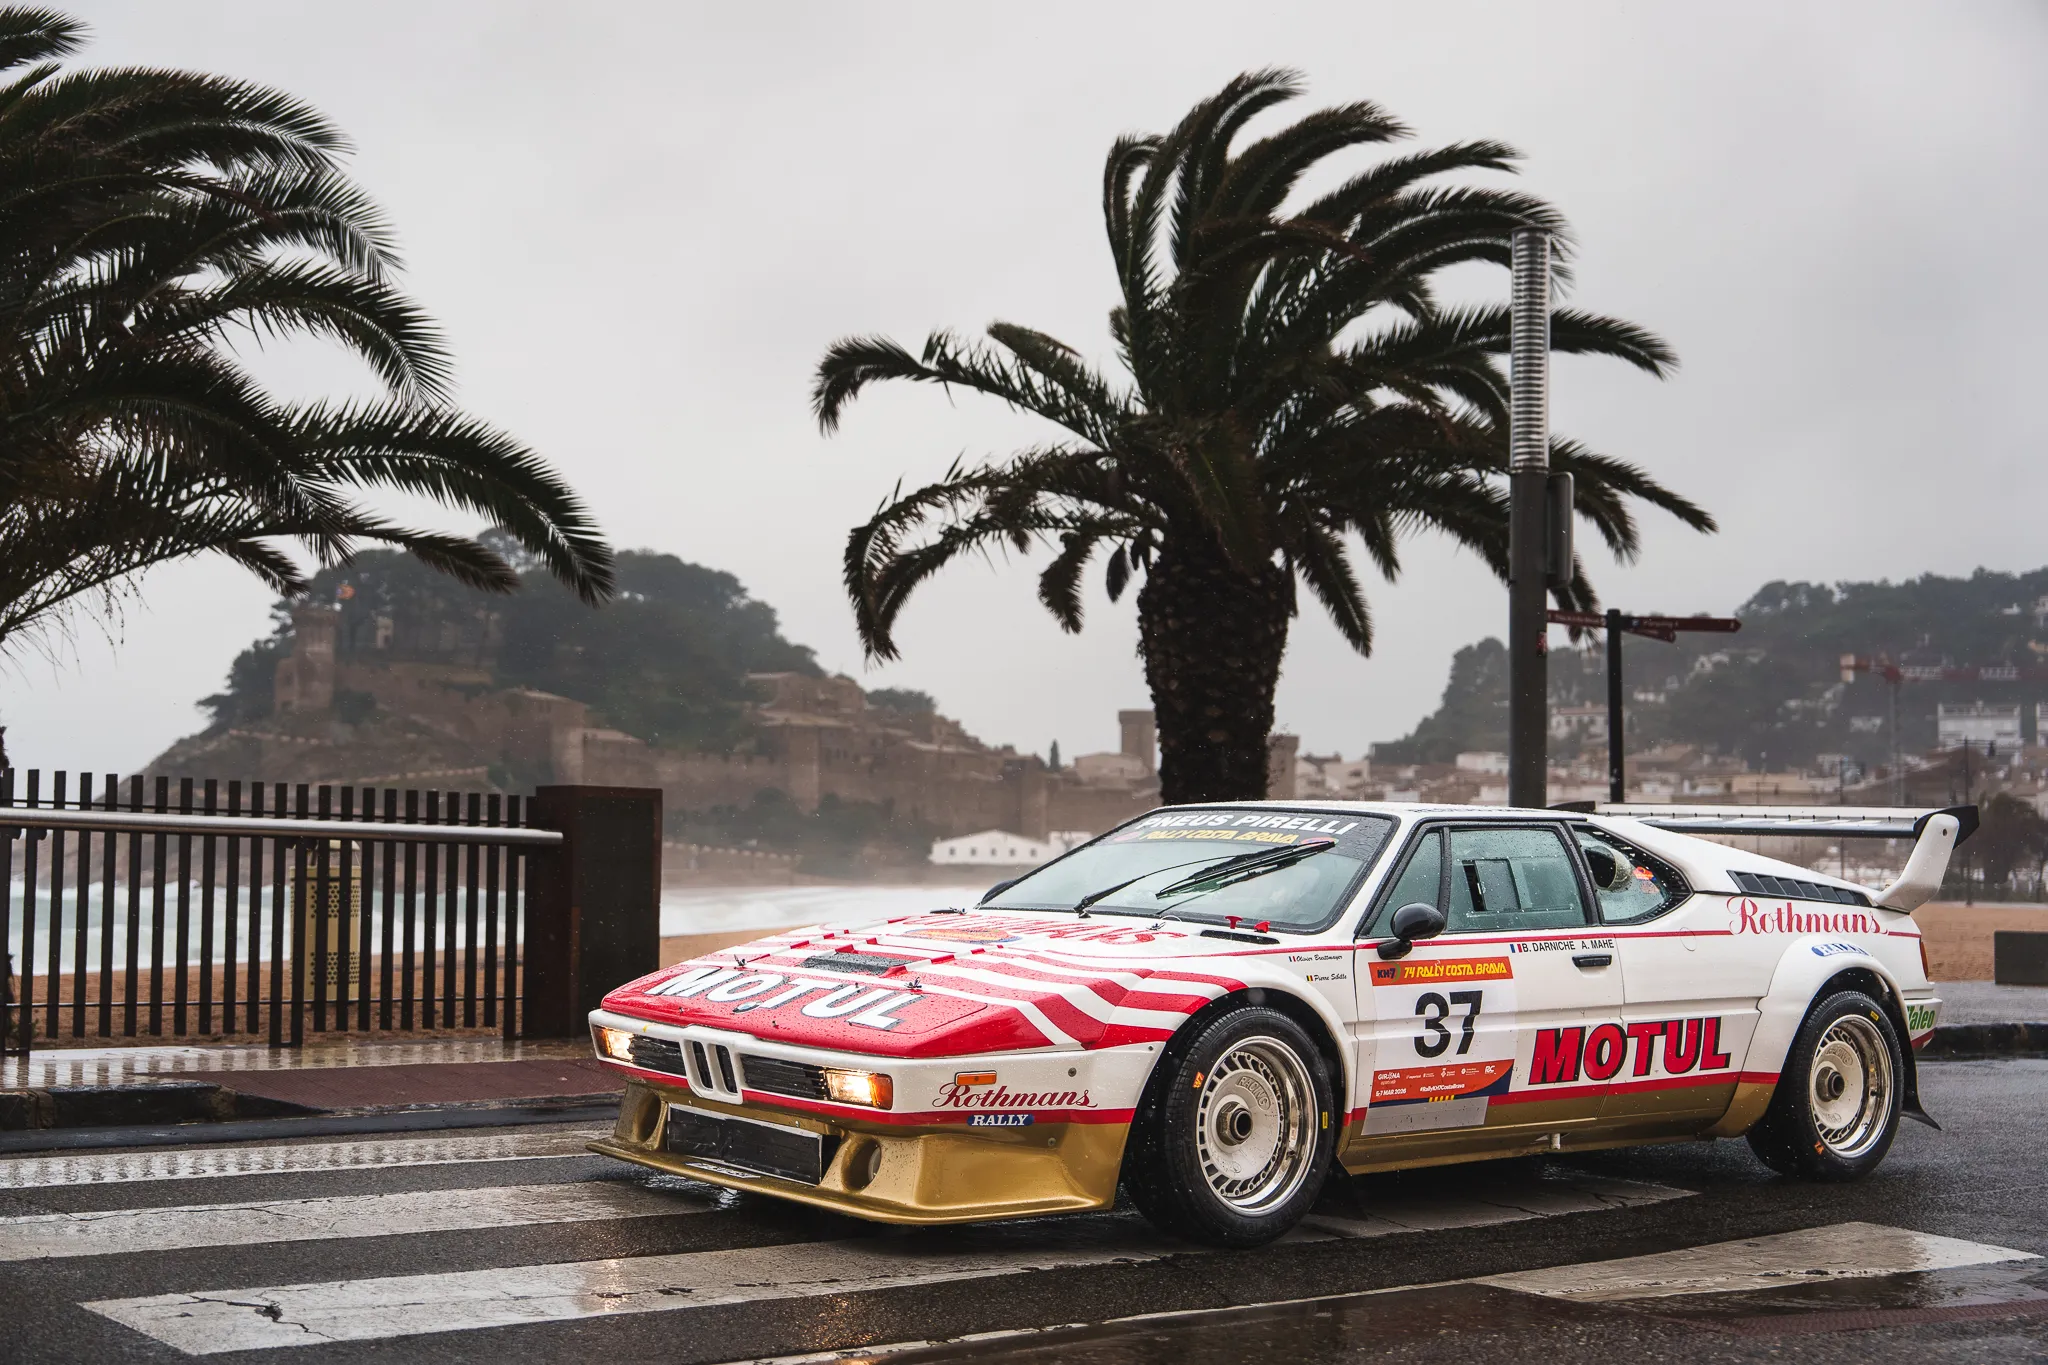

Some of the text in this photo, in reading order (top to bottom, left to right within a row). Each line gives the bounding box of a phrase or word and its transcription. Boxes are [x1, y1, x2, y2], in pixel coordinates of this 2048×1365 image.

[1136, 814, 1359, 836] PNEUS PIRELLI
[1140, 830, 1190, 840] RALLY
[1188, 830, 1239, 840] COSTA
[1234, 831, 1300, 845] BRAVA
[1726, 896, 1889, 936] Rothmans
[1522, 939, 1615, 953] B. DARNICHE A. MAHE
[1403, 966, 1416, 979] 74
[1416, 964, 1445, 978] RALLY
[1446, 962, 1474, 977] COSTA
[1475, 961, 1507, 975] BRAVA
[642, 966, 927, 1031] MOTUL
[1413, 989, 1483, 1058] 37
[1528, 1016, 1732, 1086] MOTUL
[932, 1082, 1098, 1108] Rothmans
[971, 1114, 1029, 1126] RALLY
